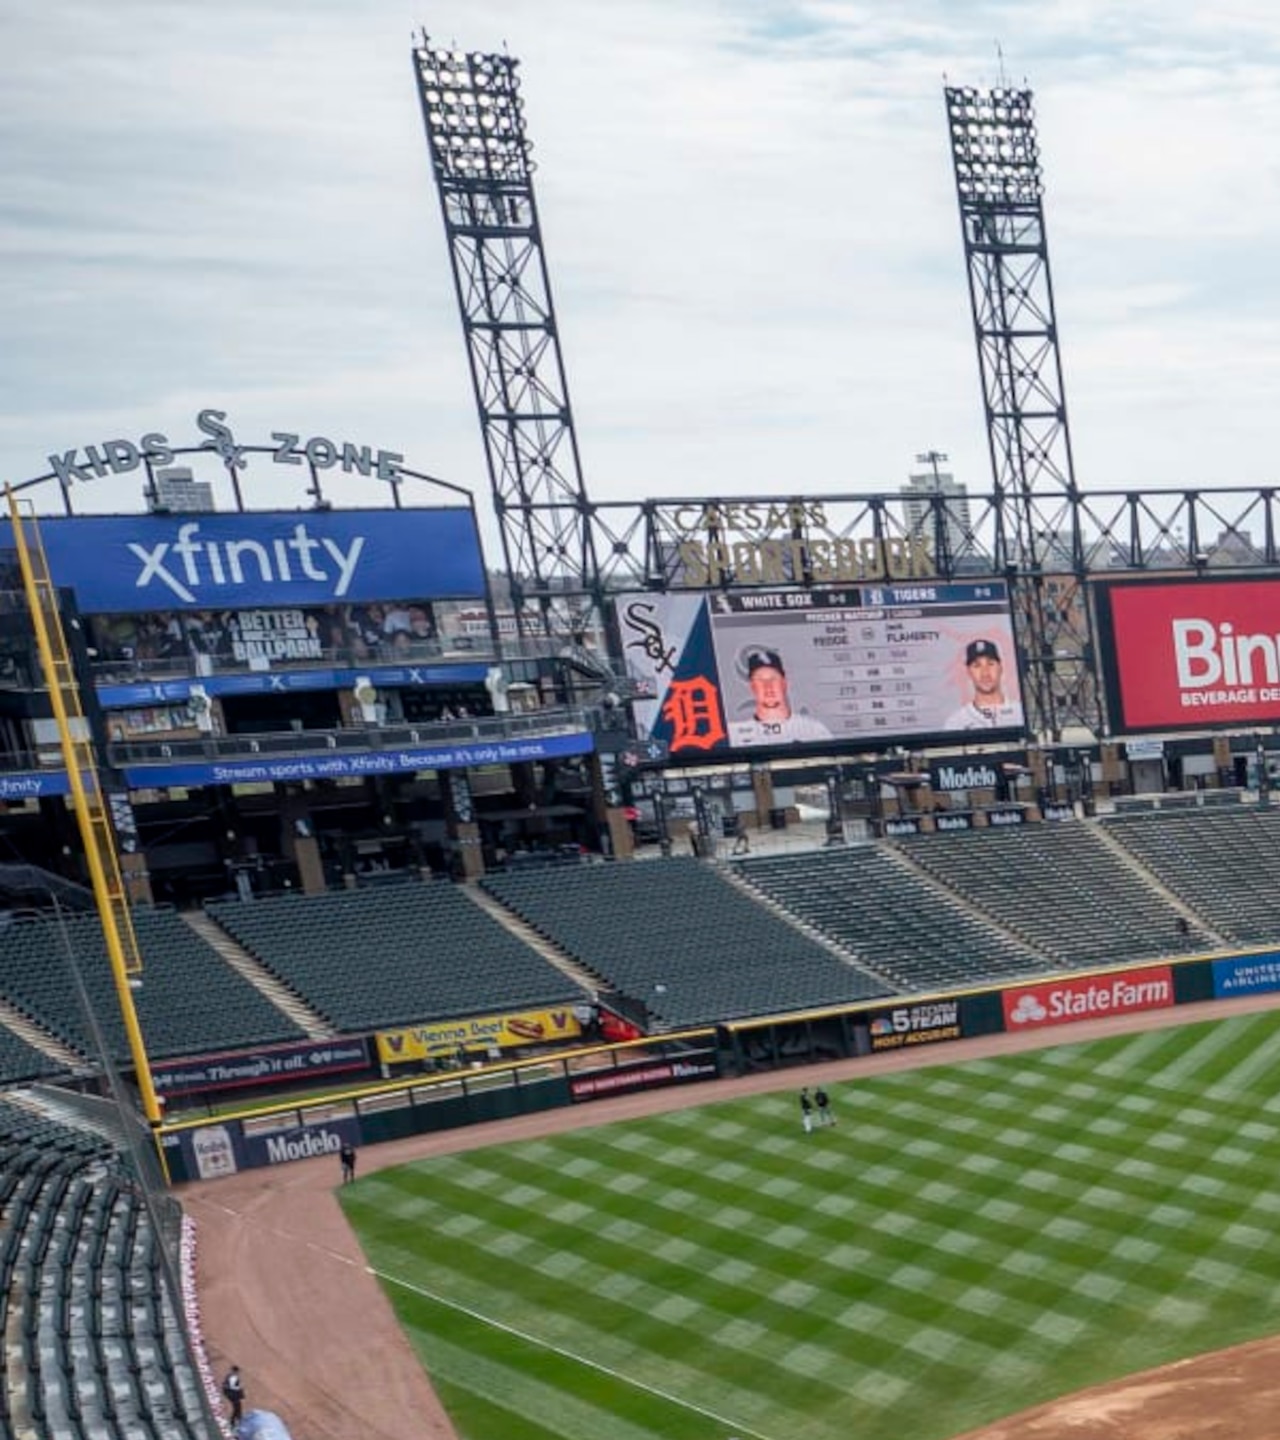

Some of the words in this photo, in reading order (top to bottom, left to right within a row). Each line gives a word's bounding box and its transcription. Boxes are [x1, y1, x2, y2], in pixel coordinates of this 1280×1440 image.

[49, 432, 176, 486] KIDS
[271, 432, 405, 485] ZONE
[674, 503, 829, 532] CAESARS
[127, 522, 366, 603] xfinity
[680, 532, 934, 588] SPORTSBOOK
[741, 595, 783, 610] WHITE
[785, 594, 813, 609] SOX
[892, 588, 937, 602] TIGERS
[238, 609, 305, 630] BETTER
[233, 638, 323, 662] BALLPARK
[1181, 689, 1257, 706] BEVERAGE
[213, 766, 265, 782] Stream
[269, 762, 310, 781] sports
[312, 759, 348, 776] with
[401, 752, 452, 769] Because
[938, 765, 997, 791] Modelo
[892, 1009, 911, 1033] 5
[910, 1001, 957, 1018] STORM
[910, 1012, 957, 1030] TEAM
[413, 1027, 466, 1044] Vienna
[470, 1022, 504, 1036] Beef
[207, 1060, 270, 1081] Through
[270, 1058, 283, 1072] it
[266, 1129, 342, 1163] Modelo
